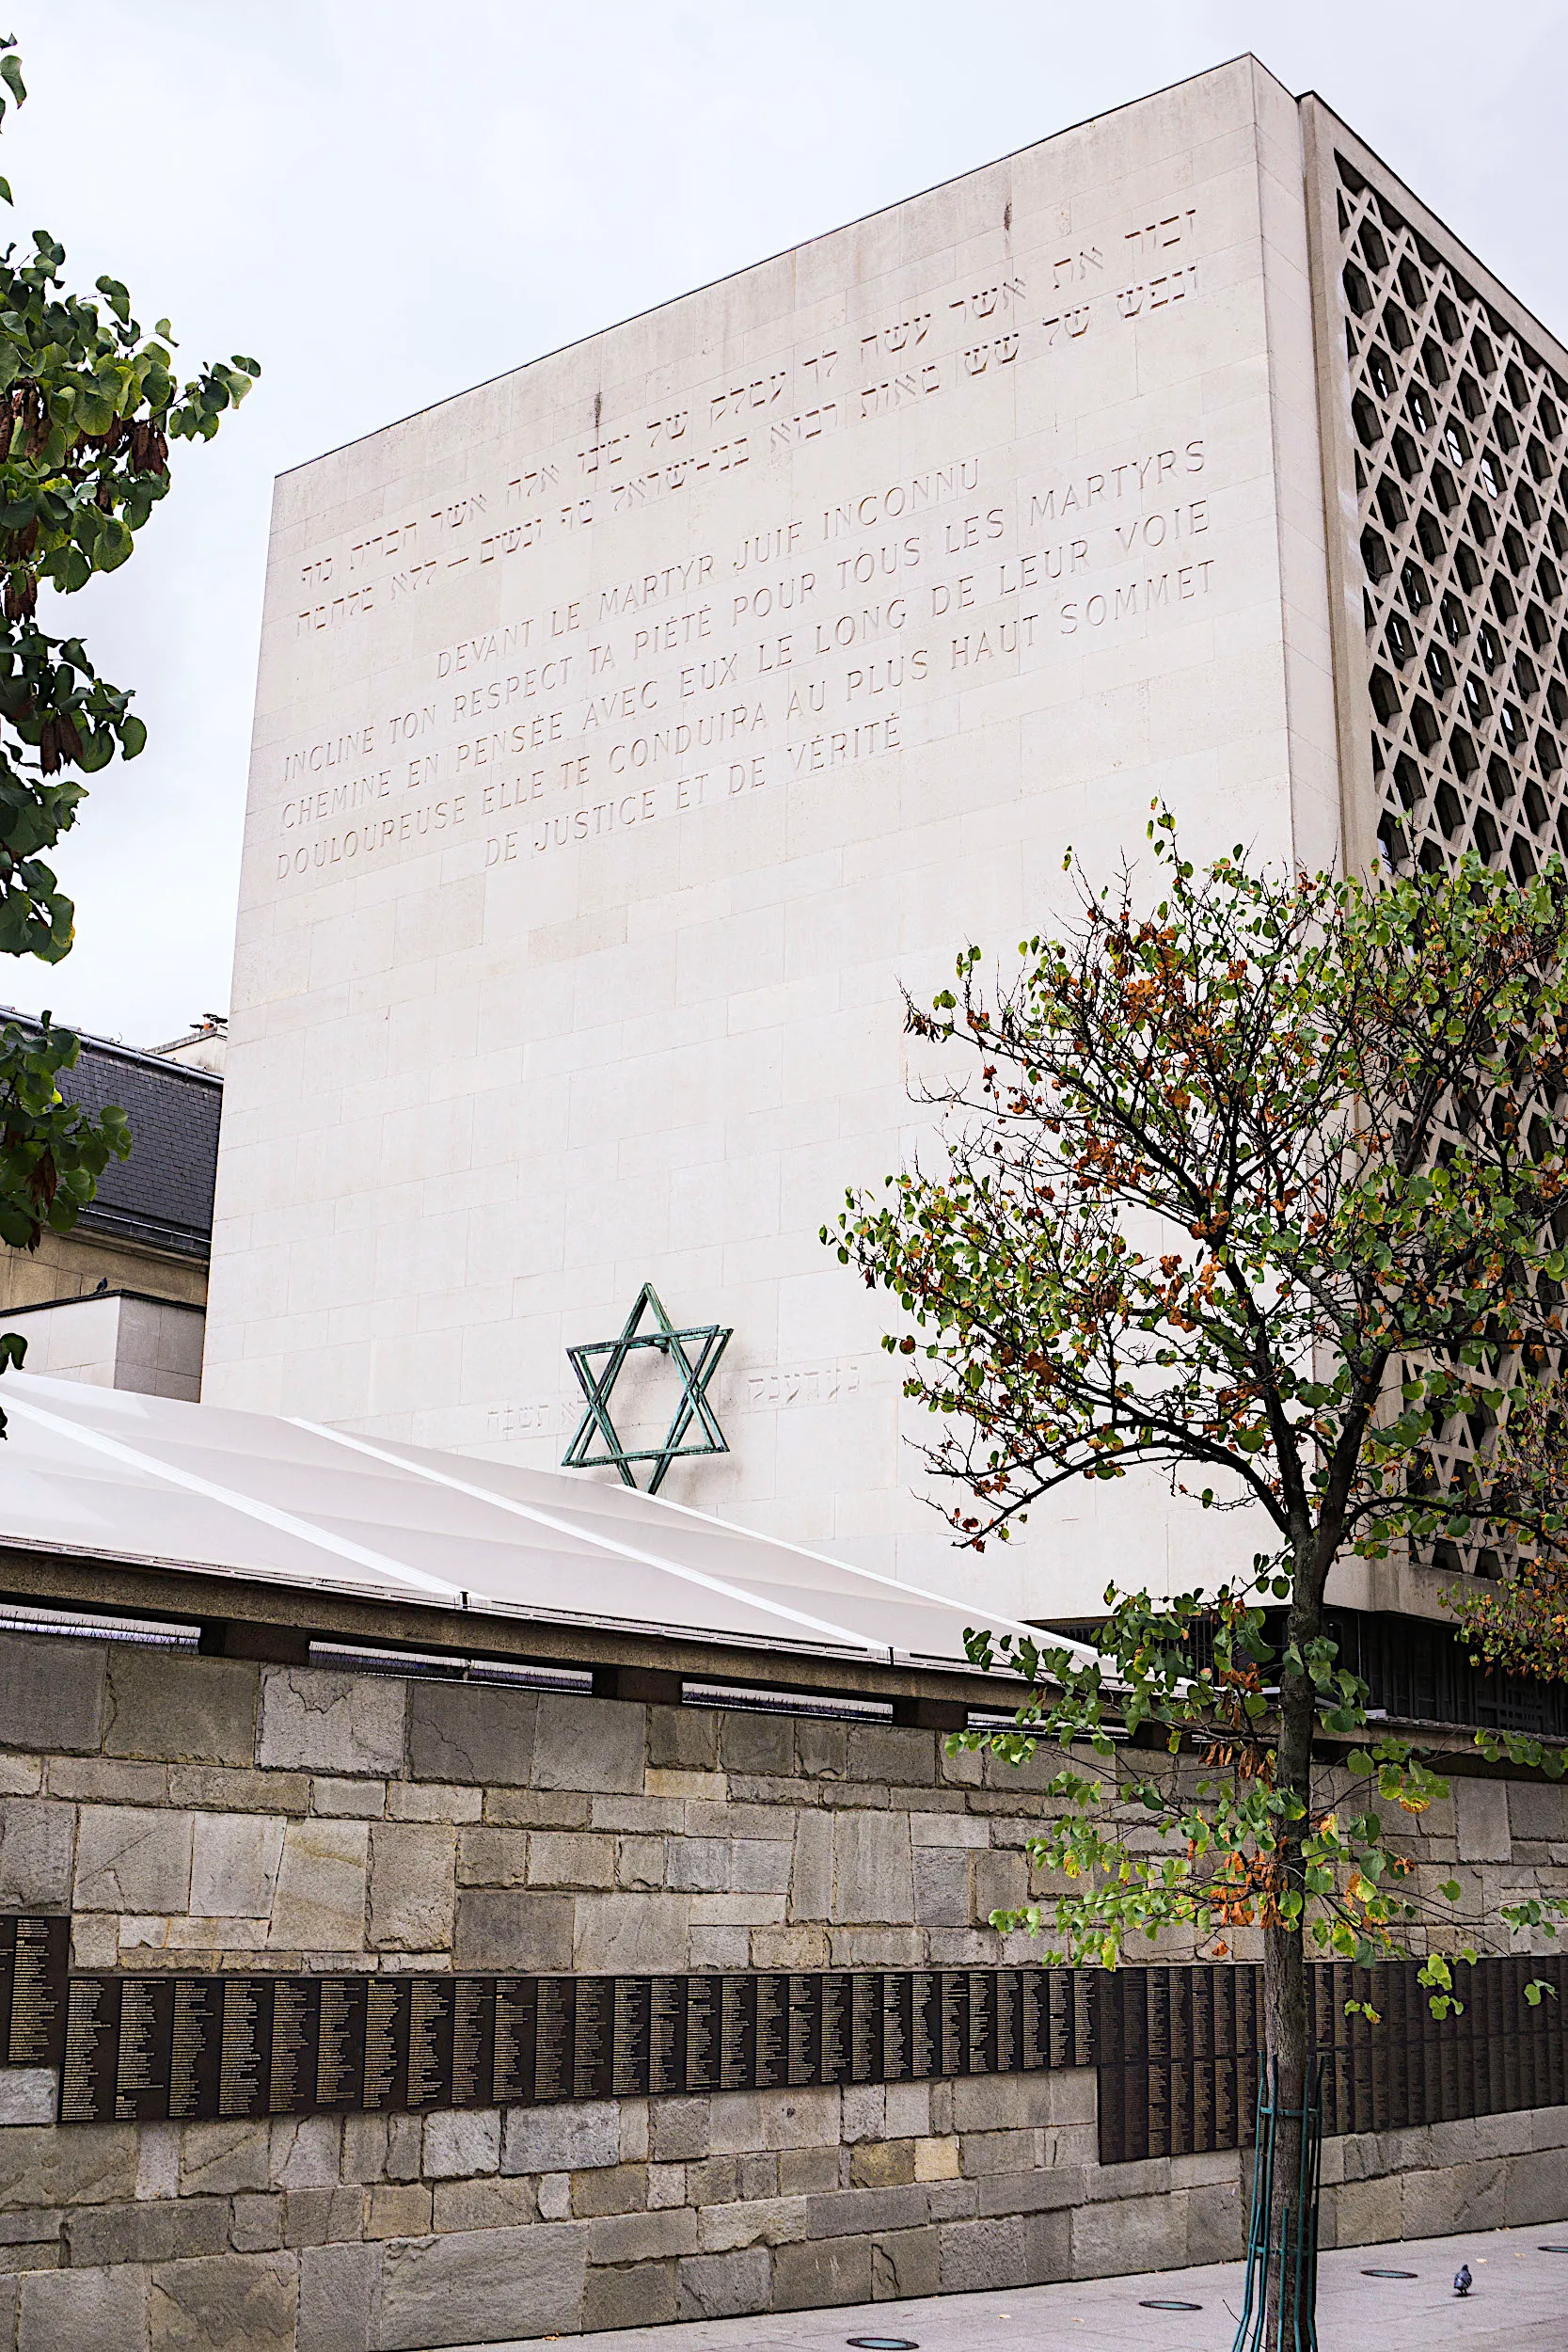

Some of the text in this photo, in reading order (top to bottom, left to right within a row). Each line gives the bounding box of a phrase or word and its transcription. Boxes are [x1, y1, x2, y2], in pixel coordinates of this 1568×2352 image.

[1125, 209, 1196, 254] זכור
[1053, 247, 1103, 290] את
[949, 278, 1026, 324] אשר
[1117, 265, 1196, 320] ונפש
[861, 313, 931, 363] עשה
[1042, 306, 1089, 346] של
[802, 350, 838, 388] לך
[964, 332, 1020, 376] שש
[710, 371, 786, 430] עמלק
[861, 365, 941, 419] מאות
[646, 411, 689, 448] של
[770, 403, 838, 453] רבוא
[578, 434, 630, 474] ימינו
[507, 465, 560, 504] אלה
[431, 494, 487, 532] אשר
[349, 522, 418, 570] הכרית
[481, 517, 543, 564] ונשים
[391, 561, 437, 600] ללא
[436, 458, 978, 679] DEVANT LE MARTYR JUIF INCONNU
[283, 440, 1205, 782] INCLINE TON RESPECT TA PIÉTÉ POUR TOUS LES MARTYRS
[297, 586, 373, 637] מלחמה
[281, 500, 1209, 830] CHEMINE EN PENSÉE AVEC EUX LE LONG DE LEUR VOIE
[276, 559, 1215, 882] DOULOUREUSE ELLE TE CONDUIRA AU PLUS HAUT SOMMET
[484, 712, 900, 867] DE JUSTICE ET DE VÉRITÉ
